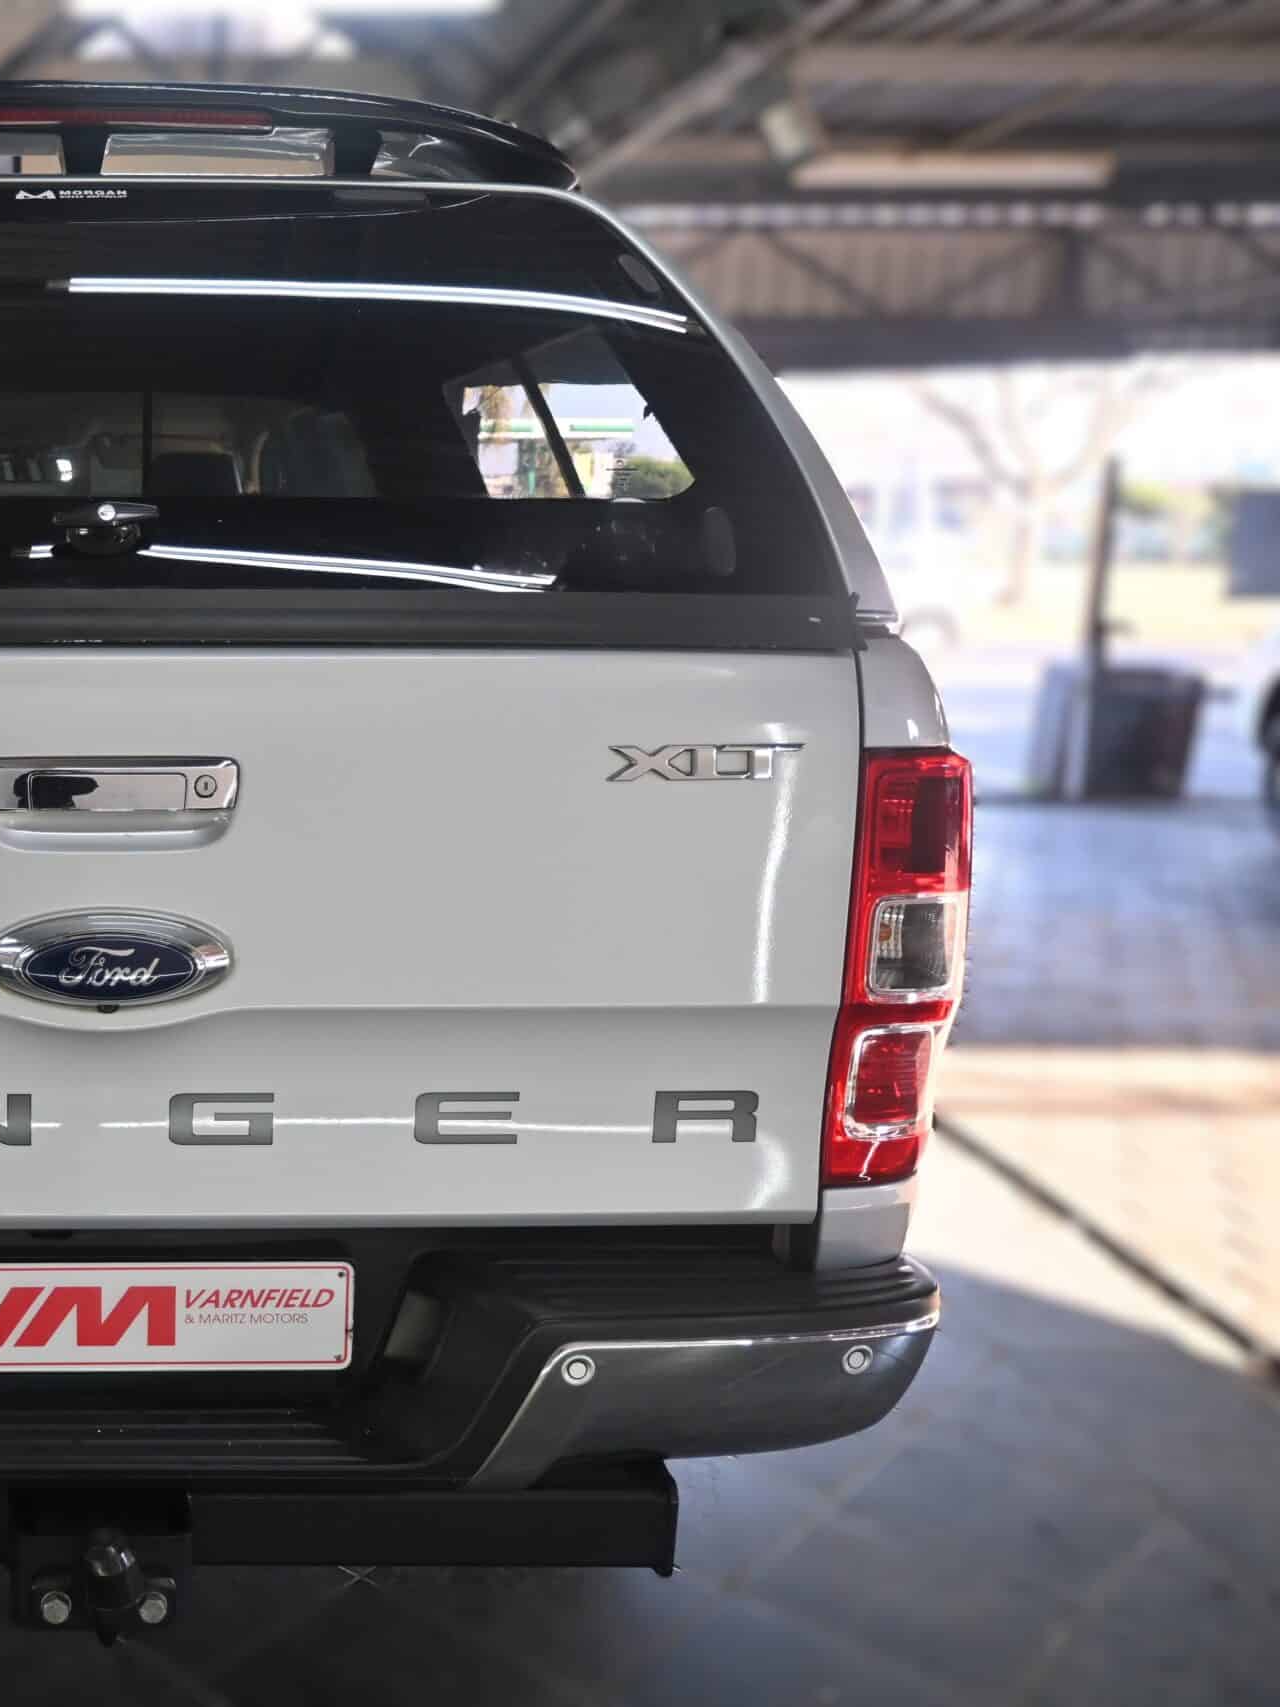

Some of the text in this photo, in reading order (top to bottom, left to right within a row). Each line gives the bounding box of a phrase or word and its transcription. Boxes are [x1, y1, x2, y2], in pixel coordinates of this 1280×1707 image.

[606, 743, 806, 782] XLT
[59, 946, 160, 988] Ford
[185, 1288, 335, 1308] VARNFIELD
[184, 1313, 308, 1324] & MARITZ MOTORS
